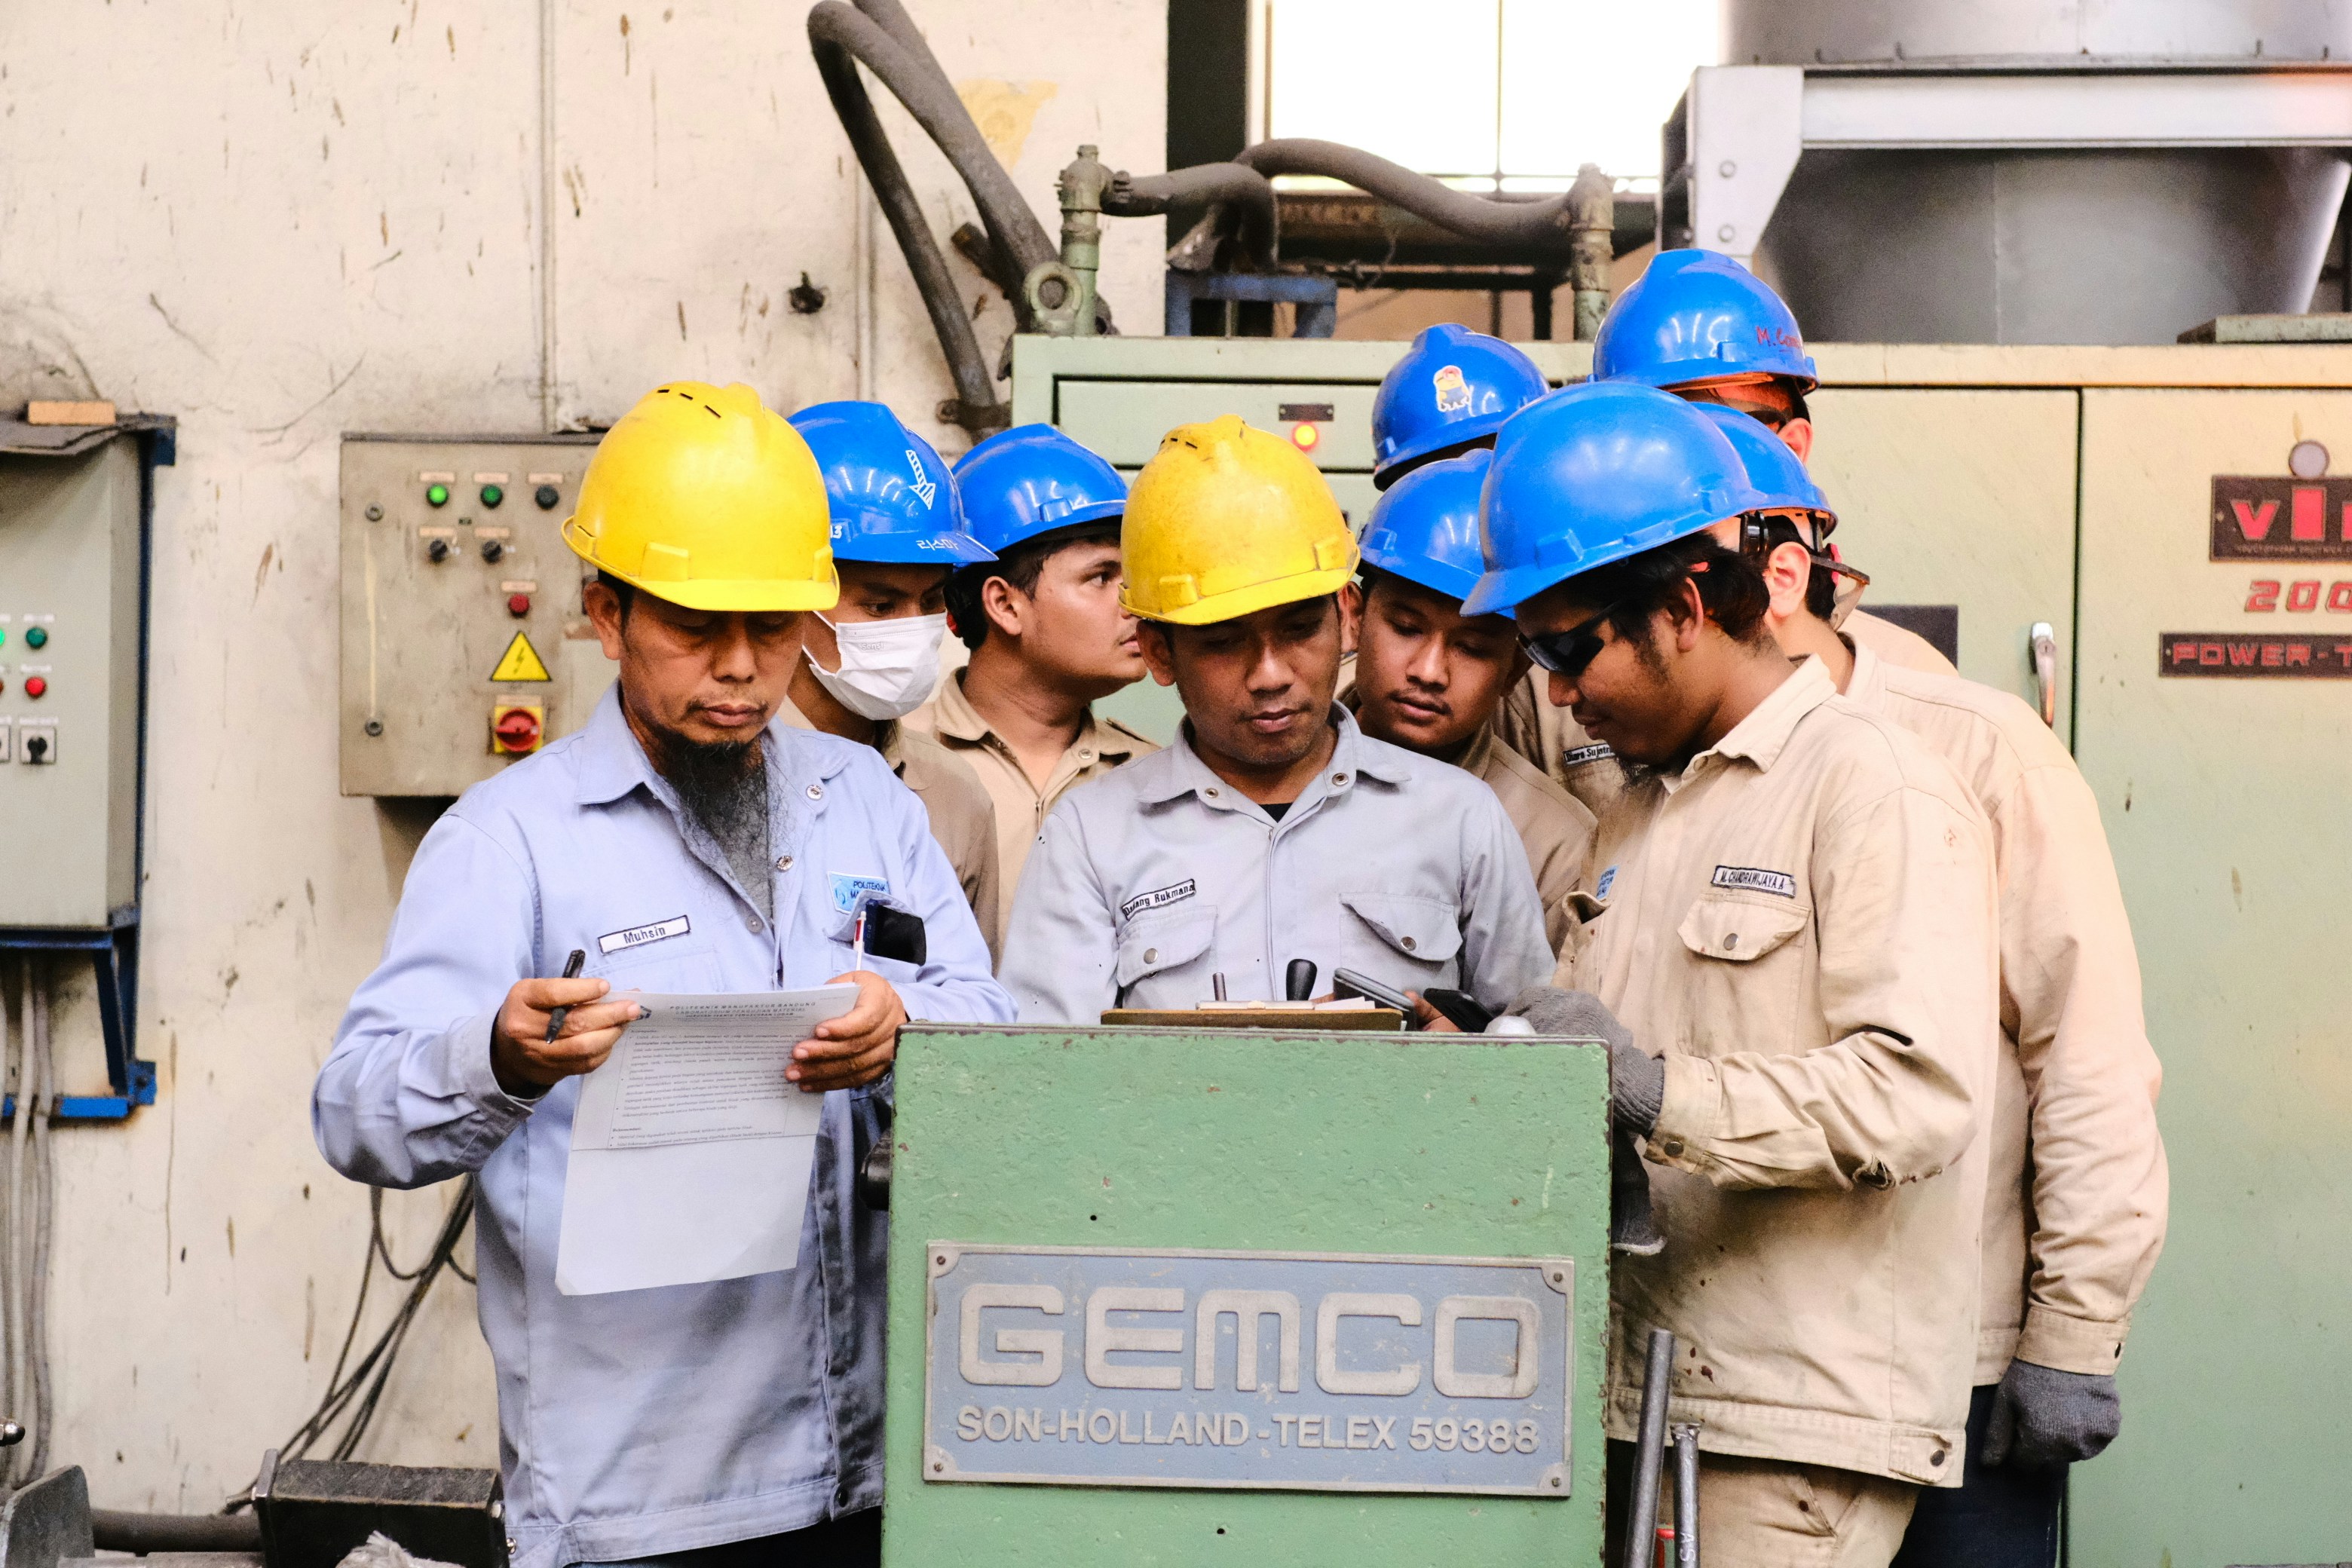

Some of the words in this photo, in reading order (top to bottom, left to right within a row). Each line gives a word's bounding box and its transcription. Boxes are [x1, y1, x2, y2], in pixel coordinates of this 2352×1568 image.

[861, 642, 884, 651] Sensi
[1154, 884, 1195, 903] Rukmana
[623, 926, 666, 944] Muhsin
[959, 1283, 1541, 1399] GEMCO
[957, 1404, 1249, 1447] SON-HOLLAND
[1408, 1416, 1540, 1454] 59388
